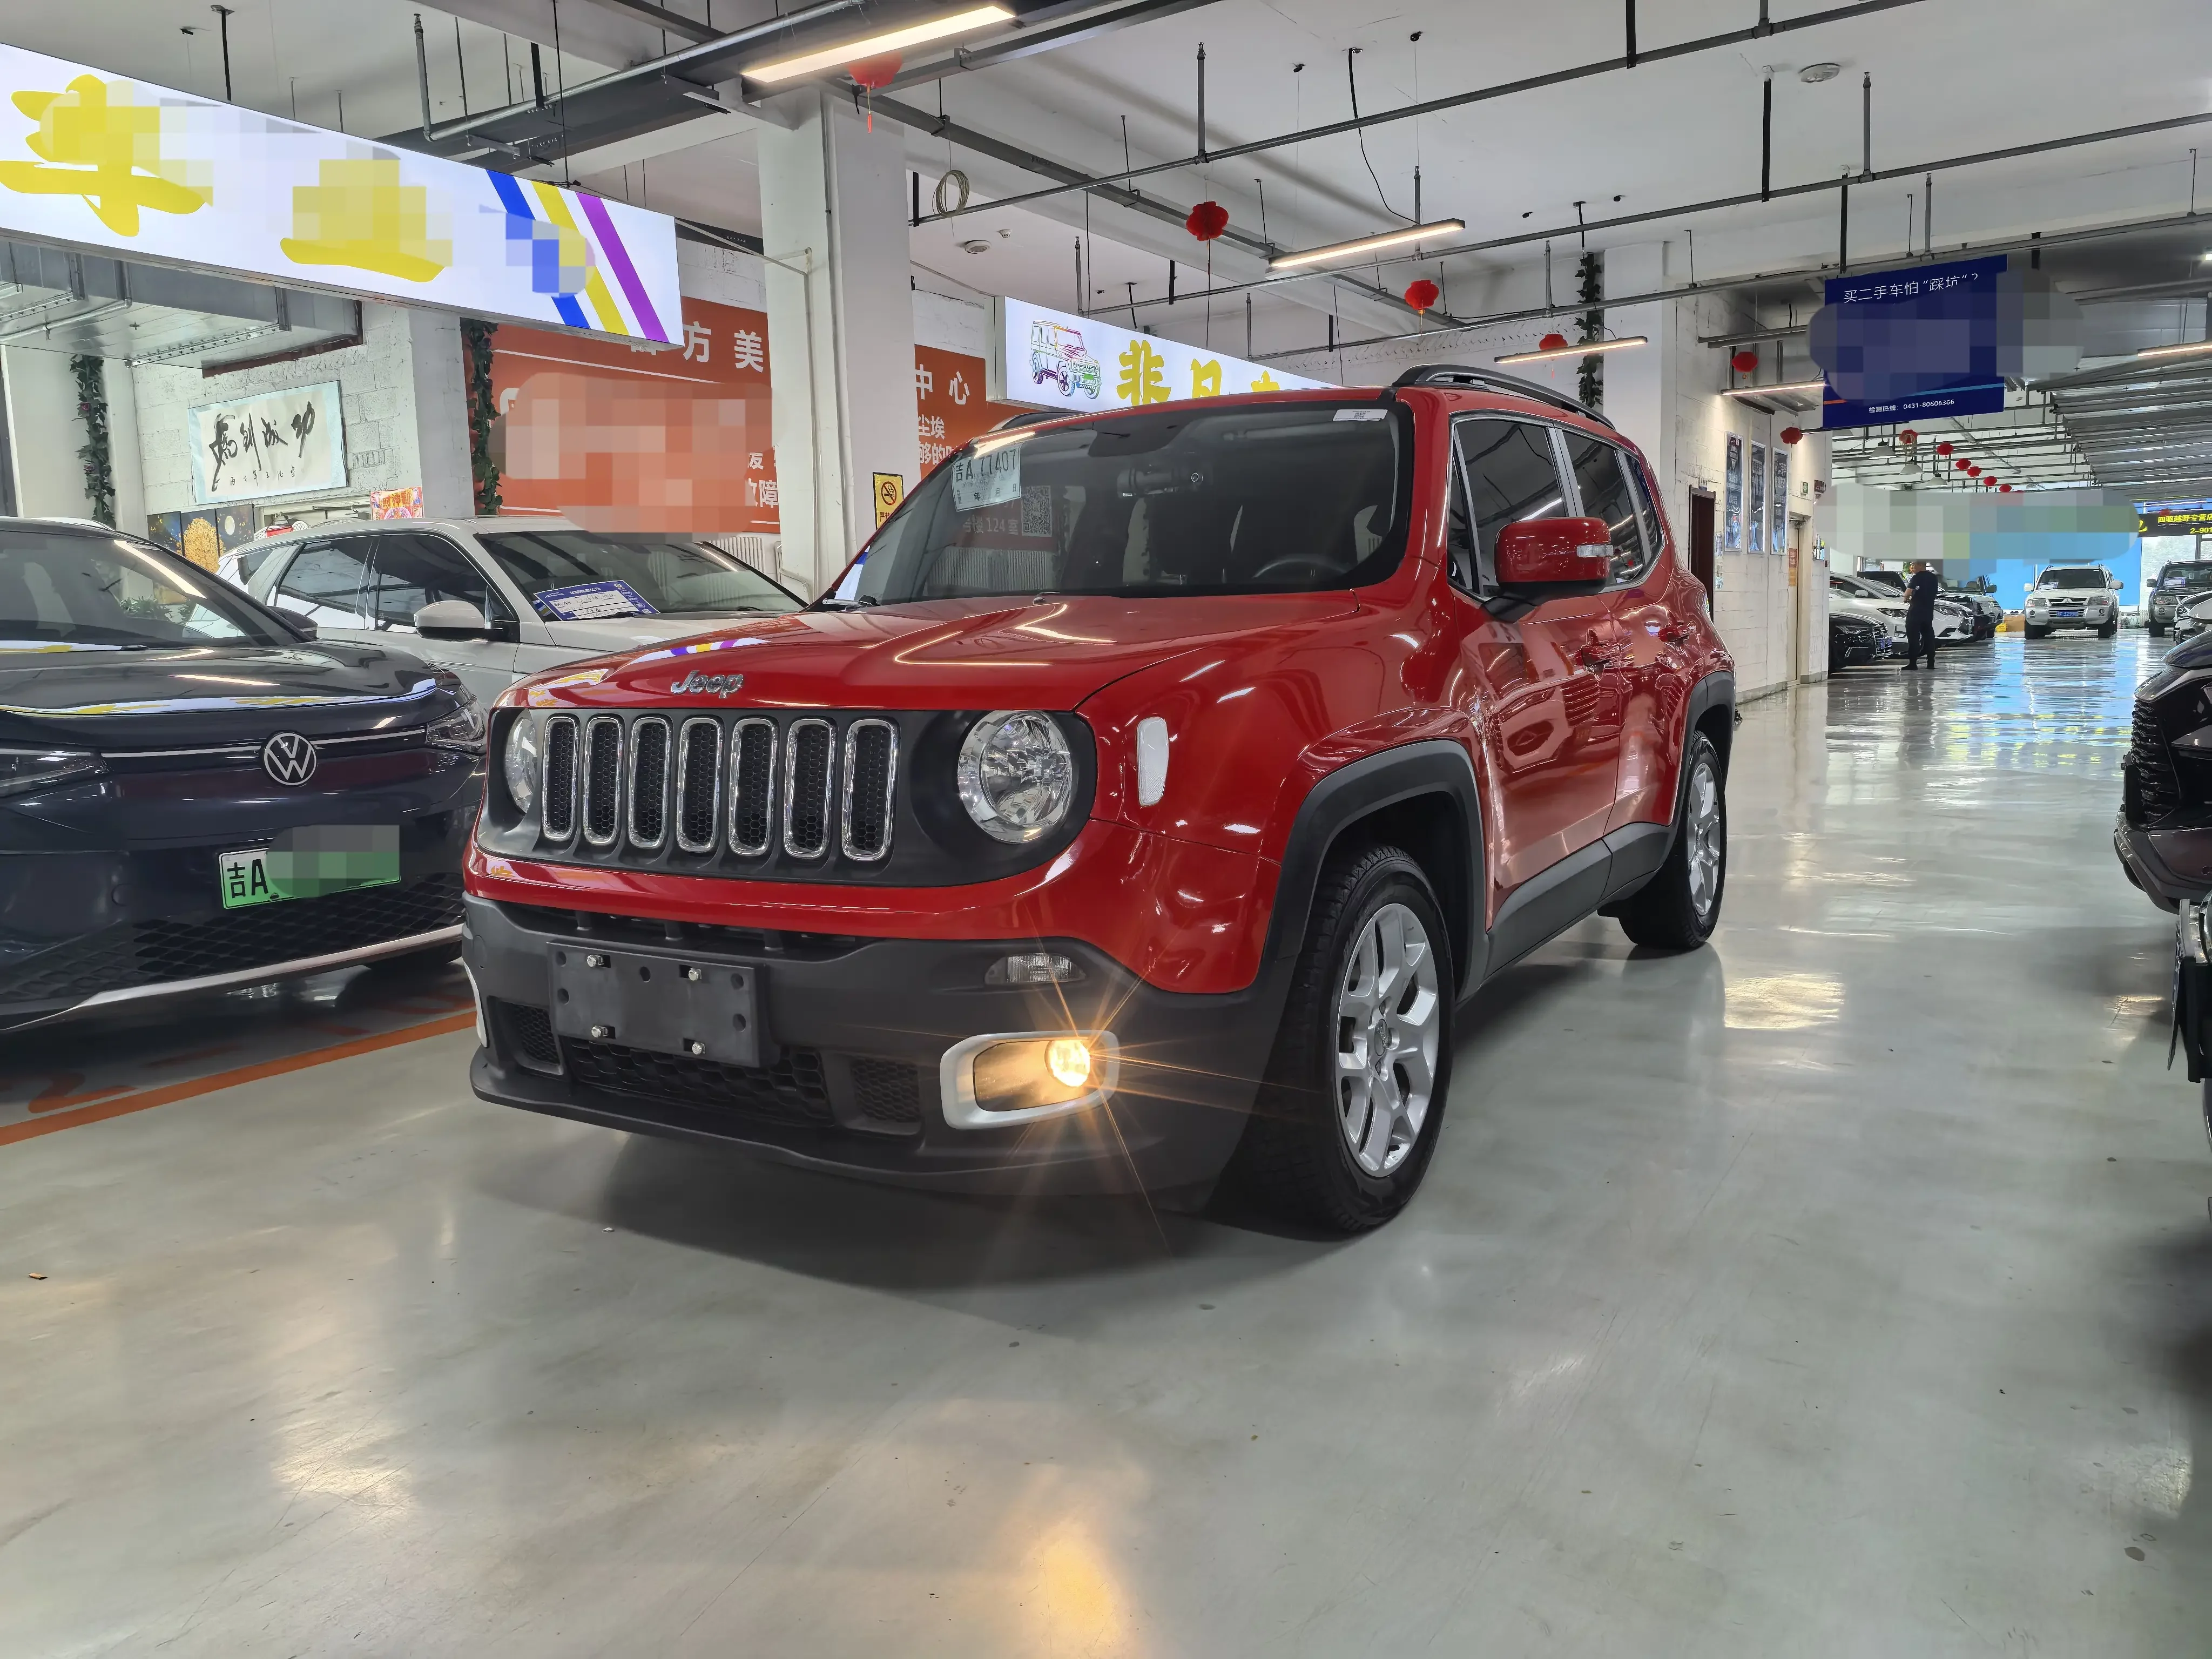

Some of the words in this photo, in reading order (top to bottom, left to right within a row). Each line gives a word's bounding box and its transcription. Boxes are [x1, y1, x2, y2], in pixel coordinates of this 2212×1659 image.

[915, 364, 970, 405] 中心
[1903, 399, 1954, 409] 0431-80606366
[919, 442, 954, 465] 够的
[671, 670, 744, 699] Jeep
